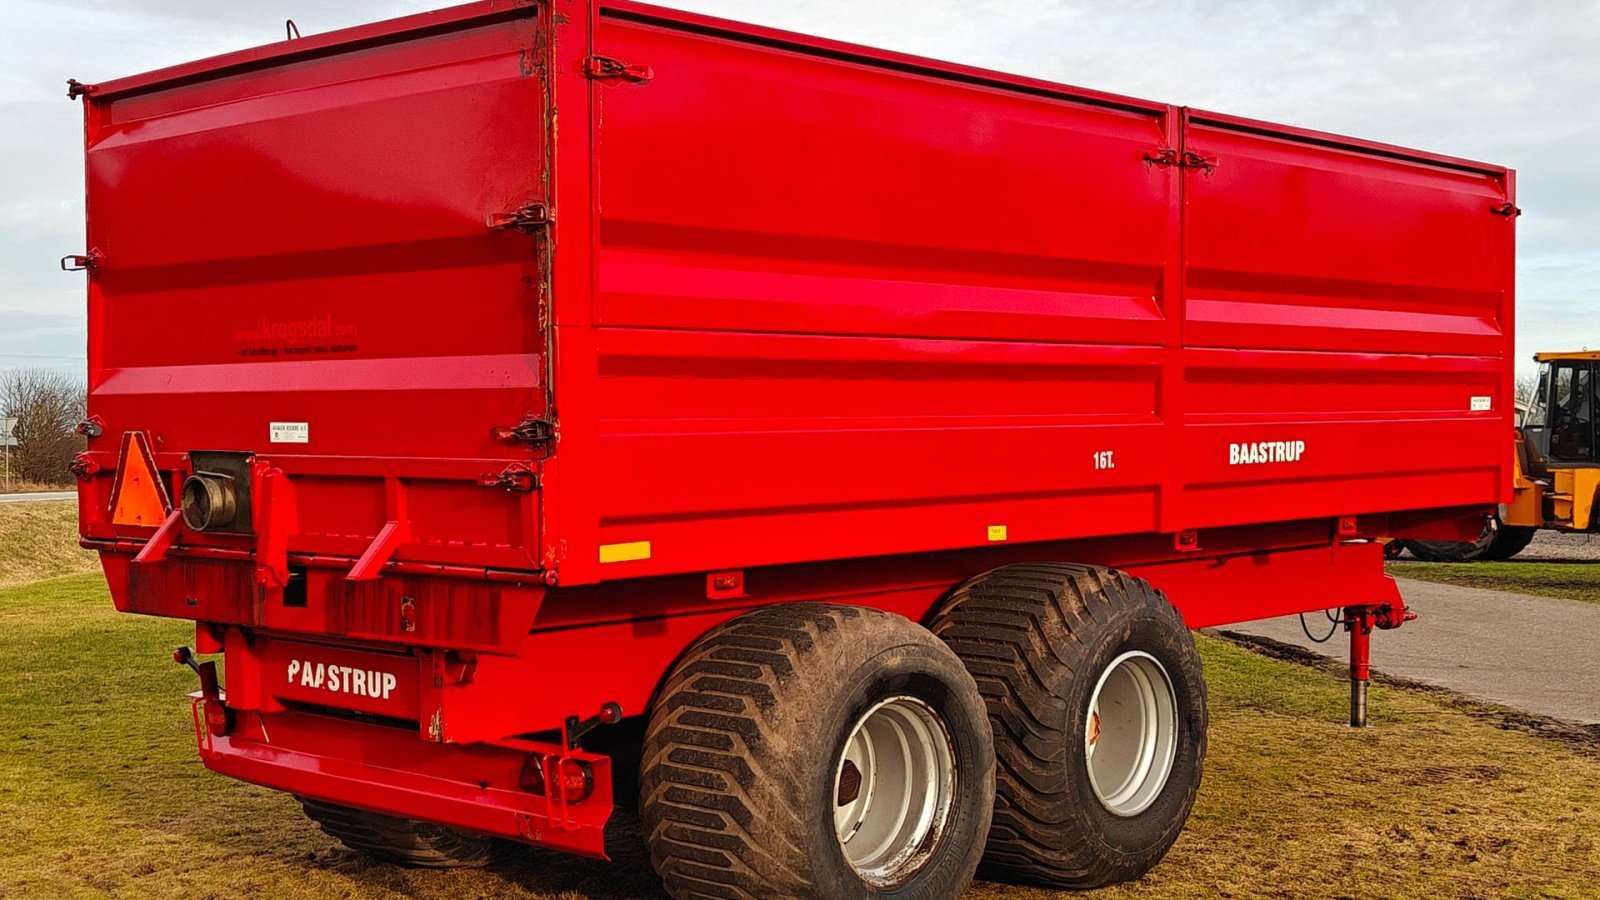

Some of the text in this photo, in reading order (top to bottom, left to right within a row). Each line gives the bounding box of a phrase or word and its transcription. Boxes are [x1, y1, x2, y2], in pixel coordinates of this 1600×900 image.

[235, 313, 357, 343] www.krogsdal.com
[1093, 451, 1115, 469] 16T.
[1229, 440, 1305, 465] BAASTRUP
